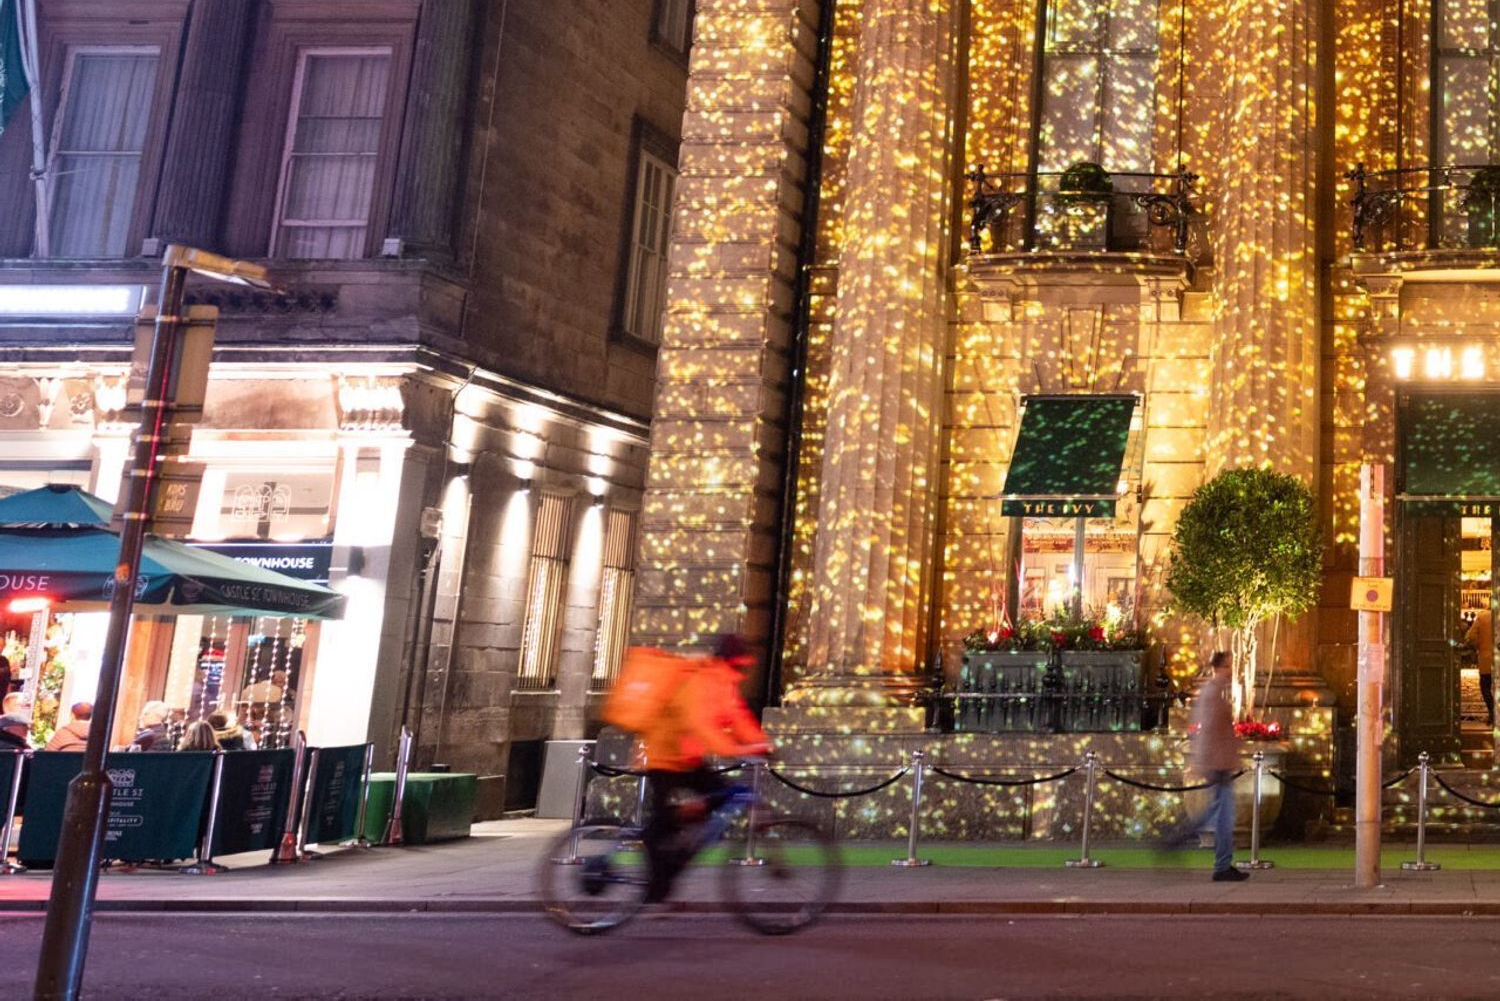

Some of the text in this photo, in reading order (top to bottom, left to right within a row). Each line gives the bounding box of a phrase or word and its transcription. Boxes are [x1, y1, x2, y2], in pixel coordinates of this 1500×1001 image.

[1391, 347, 1485, 379] THE
[1024, 504, 1095, 514] THE IVY
[1461, 505, 1491, 515] THE
